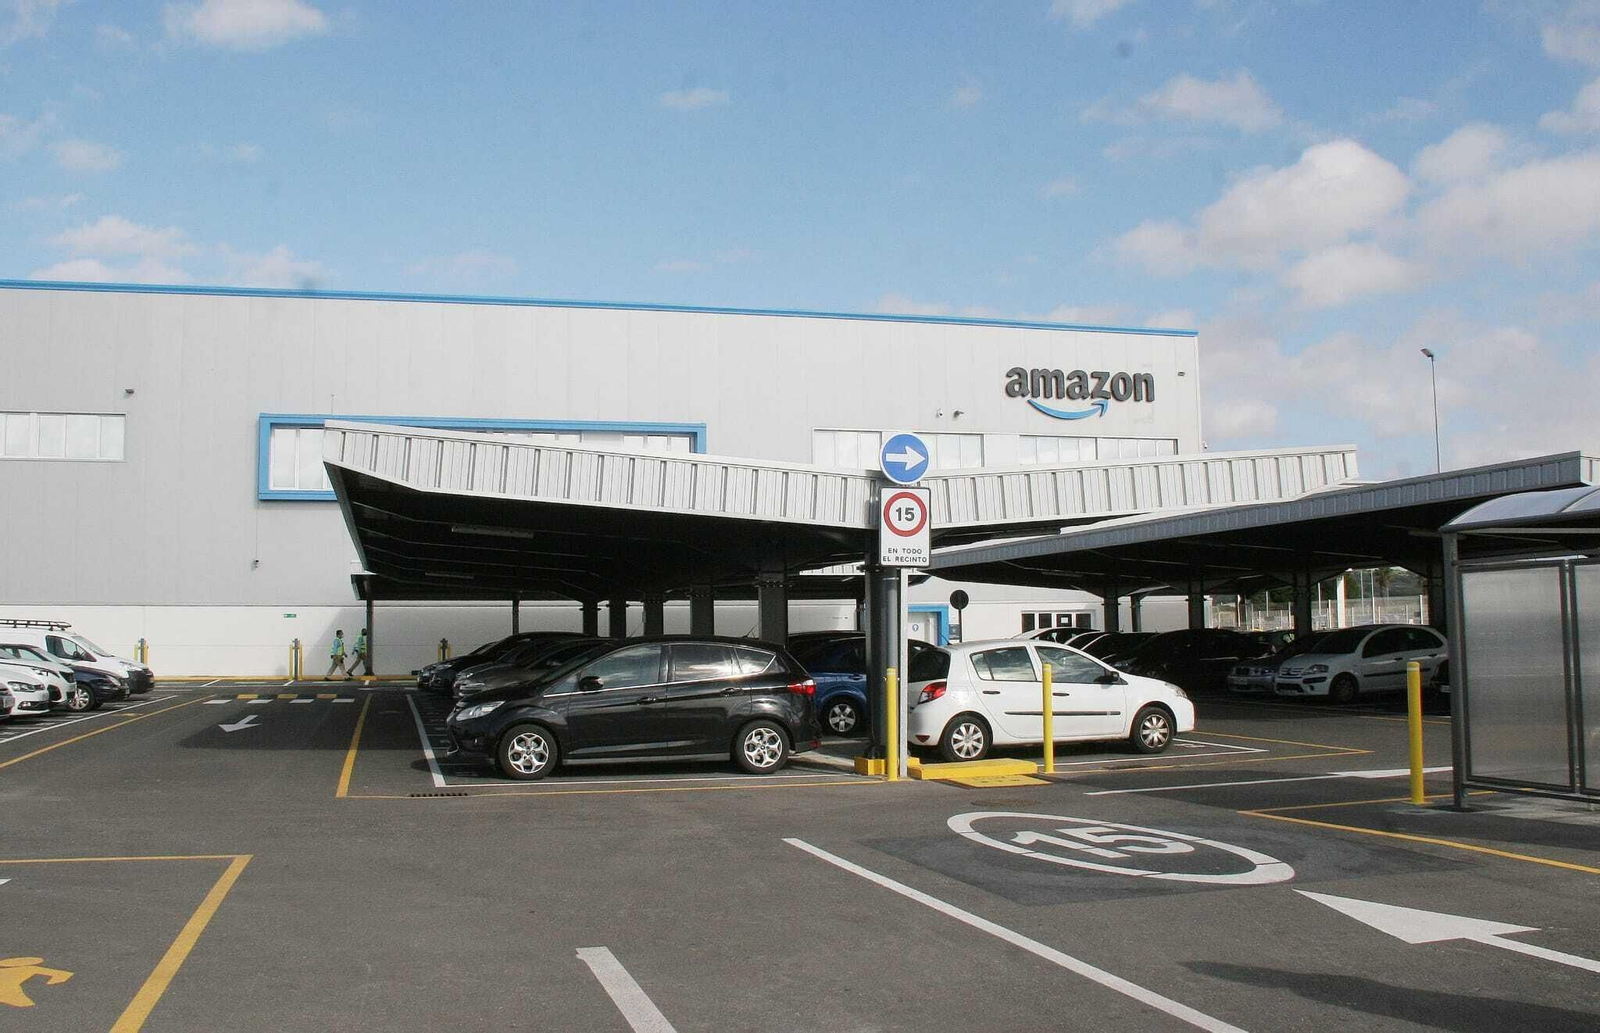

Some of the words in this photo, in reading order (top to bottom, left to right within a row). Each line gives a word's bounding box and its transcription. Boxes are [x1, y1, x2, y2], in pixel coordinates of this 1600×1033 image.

[1005, 366, 1155, 402] amazon
[895, 507, 915, 522] 15
[1010, 826, 1195, 859] 15
